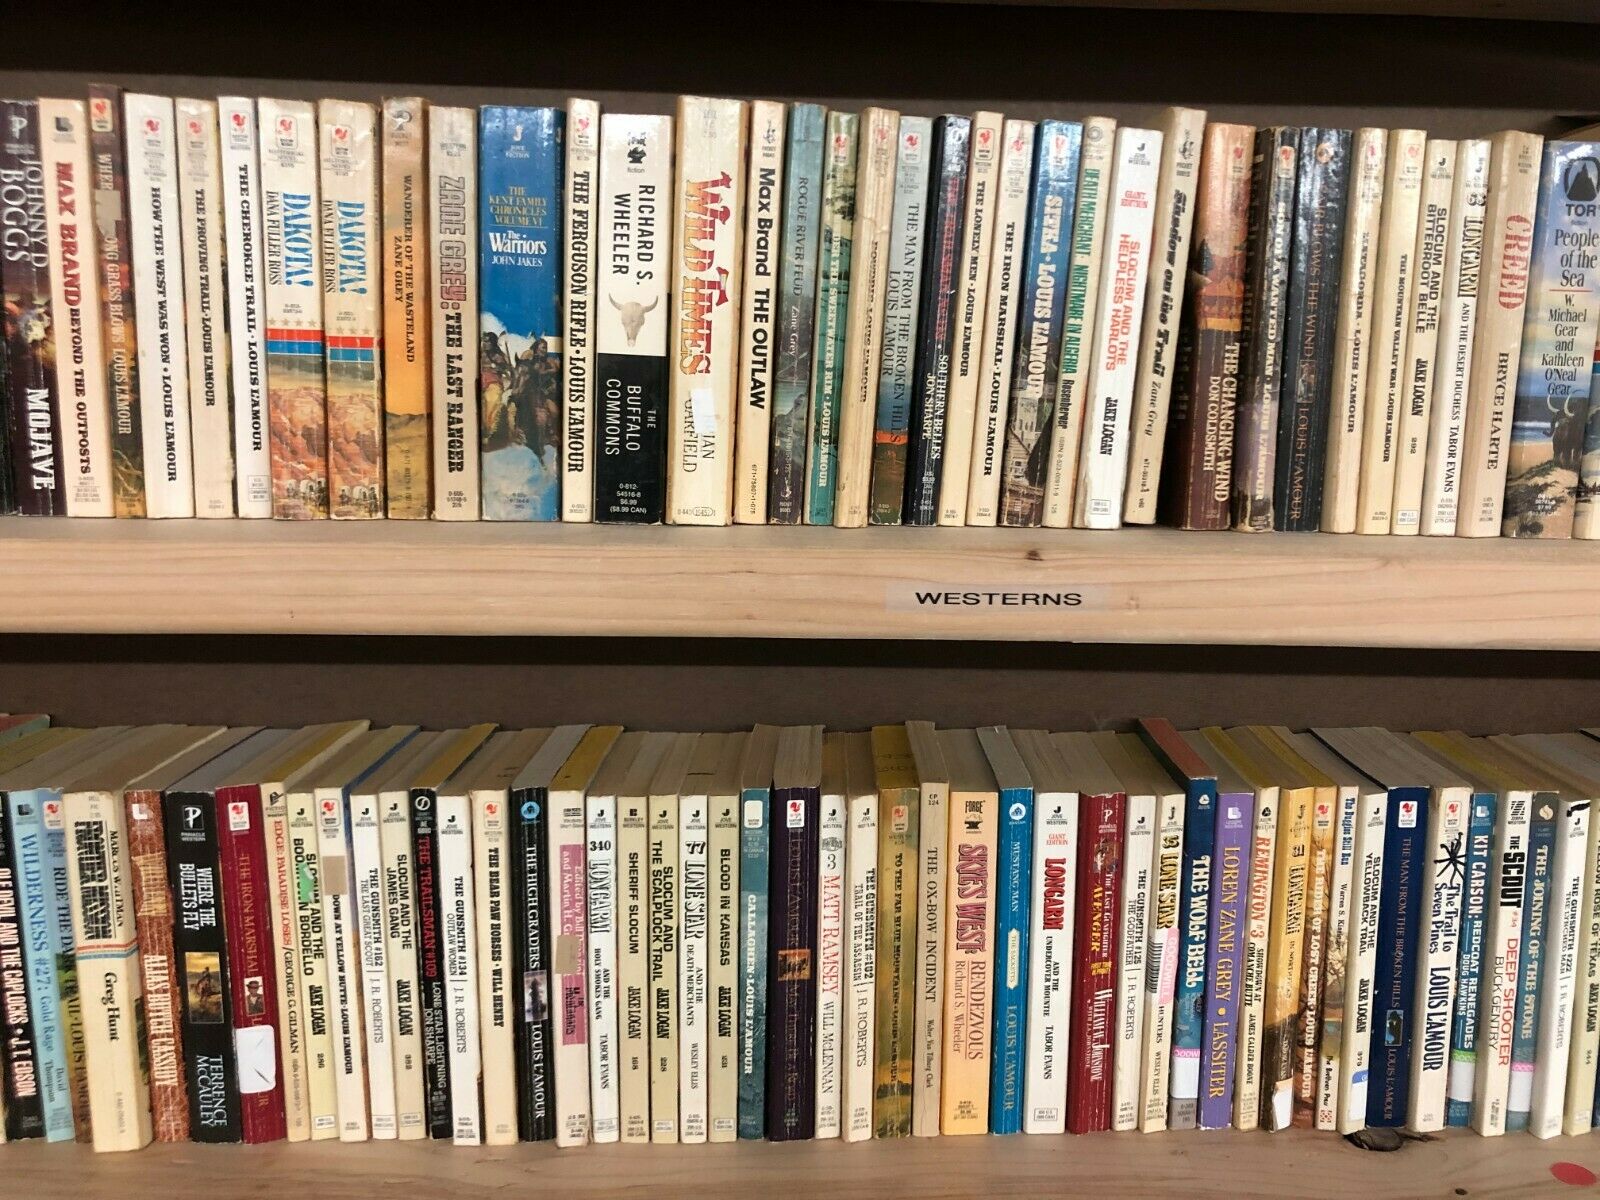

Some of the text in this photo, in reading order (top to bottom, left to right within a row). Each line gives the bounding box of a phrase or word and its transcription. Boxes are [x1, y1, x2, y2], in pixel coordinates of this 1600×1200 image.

[1, 169, 30, 262] BOGGS
[20, 157, 48, 271] JOHNNY D.
[55, 162, 82, 307] MAX BRAND
[283, 192, 313, 287] DAKOTA!
[439, 175, 466, 236] ZANE
[507, 230, 521, 241] The
[612, 193, 632, 275] WHEELER
[636, 185, 656, 286] RICHARD S.
[683, 171, 732, 272] WILD
[1555, 229, 1599, 248] People
[1565, 204, 1596, 217] TOR
[337, 201, 367, 295] DAKOTA!
[440, 239, 467, 310] GREY:
[489, 232, 548, 255] Warriors
[491, 256, 543, 268] JOHN JAKES
[1499, 214, 1533, 310] CREED
[1560, 269, 1585, 288] Sea
[1561, 249, 1597, 269] of the
[567, 173, 590, 473] THE FERGUSON RIFLE LOUIS L'AMOUR
[679, 267, 729, 376] TIMES
[749, 168, 776, 410] Max Brand THE OUTLAW
[1026, 195, 1064, 399] SITKA LOUIS L'AMOUR
[1105, 234, 1130, 371] HELPLESS HARLOTS
[1118, 241, 1141, 366] SLOCUM AND THE
[1549, 308, 1587, 323] Michael
[1564, 294, 1575, 307] W.
[70, 308, 83, 364] BEYOND
[445, 312, 463, 348] THE
[1541, 353, 1585, 367] Kathleen
[1554, 325, 1579, 337] Gear
[1555, 340, 1574, 352] and
[75, 368, 86, 397] THE
[446, 354, 463, 398] LAST
[1487, 351, 1510, 470] BRYCE HARTE
[1545, 368, 1578, 382] O'Neal
[1547, 383, 1572, 397] Gear
[26, 388, 56, 490] MOJAVE
[76, 402, 91, 474] OUTPOSTS
[447, 403, 464, 473] RANGER
[605, 379, 621, 455] COMMONS
[625, 385, 642, 451] BUFFALO
[647, 409, 657, 429] THE
[1100, 397, 1118, 456] JAKE LOGAN
[1203, 376, 1221, 471] DON COLDSMITH
[1214, 342, 1240, 502] THE CHANGING WIND
[915, 592, 1082, 606] WESTERNS
[965, 800, 984, 814] FORGE
[590, 841, 611, 852] 340
[827, 853, 836, 870] 3
[1500, 852, 1525, 908] SCOUT
[1510, 836, 1520, 852] THE
[20, 831, 51, 953] WILDERNESS
[179, 864, 200, 930] BULLETS FLY
[196, 867, 217, 927] WHERE THE
[526, 846, 540, 970] THE HIGH GRADERS
[588, 860, 611, 934] LONGARM
[652, 841, 662, 982] THE SCALPLOCK TRAIL
[663, 866, 674, 953] SLOCUM AND
[685, 861, 706, 940] LONE STAR
[719, 849, 730, 966] BLOOD IN KANSAS
[823, 875, 841, 924] MATT
[1042, 857, 1066, 930] LONGARM
[1185, 855, 1211, 988] THE WOLF BELL
[1250, 836, 1271, 938] REMINGTON #3
[1429, 883, 1447, 955] Seven Pines
[1442, 883, 1461, 954] The Trail to
[488, 847, 504, 1027] THE BEAR PAW HORSES WILL HENRY
[628, 853, 641, 1040] SHERIFF SLOCUM JAKE LOGAN
[925, 847, 938, 1003] THE OX-BOW INCIDENT
[955, 843, 988, 1061] SKYE'S WEST: RENDEZVOUS
[1464, 835, 1489, 1049] KIT CARSON: REDCOAT RENEGADES
[821, 928, 840, 996] RAMSEY
[1209, 846, 1241, 1099] LOREN ZANE GREY LASSITER
[1457, 953, 1470, 1016] DOUG HAWKINS
[101, 972, 121, 1041] Greg Hunt
[719, 986, 731, 1038] JAKE LOGAN
[823, 1001, 835, 1029] WILL
[952, 960, 966, 1054] Richard S. Wheeler
[1423, 966, 1451, 1072] LOUIS L'AMOUR
[1488, 956, 1505, 1051] BUCK GENTRY
[1499, 939, 1520, 1067] DEEP SHOOTER
[209, 1055, 228, 1127] TERRENCE
[531, 1025, 546, 1119] LOUIS L'AMOUR
